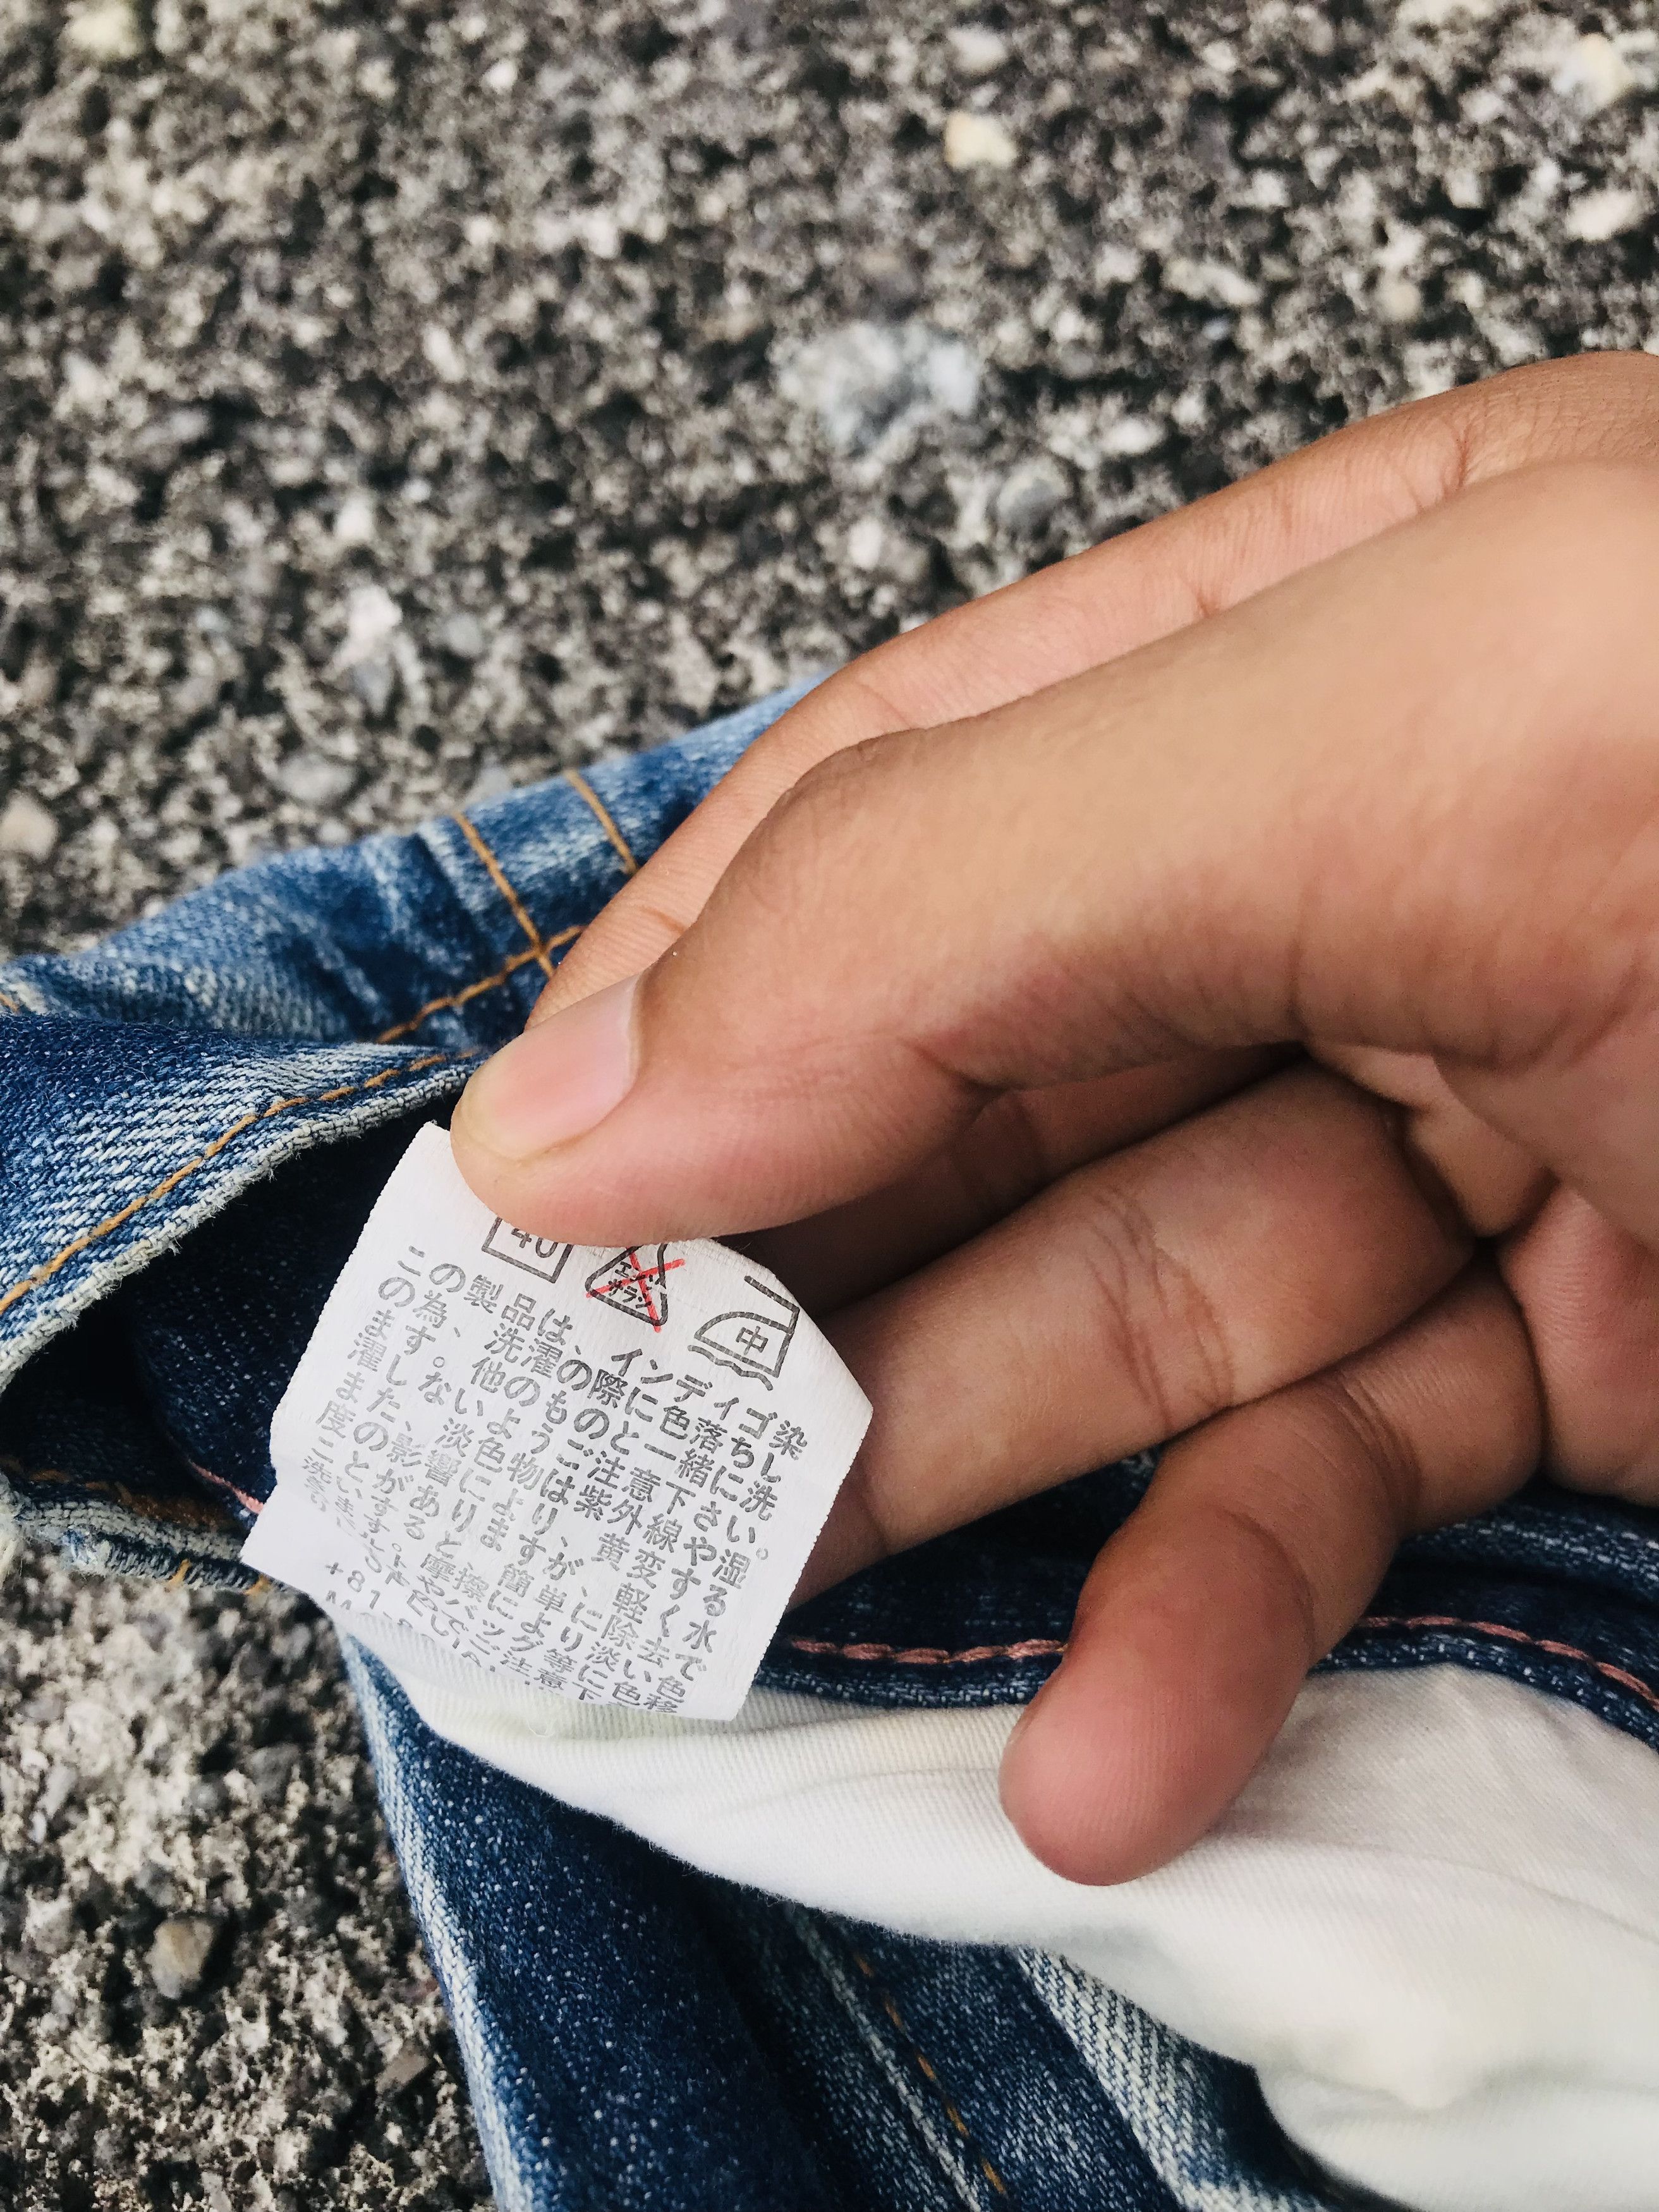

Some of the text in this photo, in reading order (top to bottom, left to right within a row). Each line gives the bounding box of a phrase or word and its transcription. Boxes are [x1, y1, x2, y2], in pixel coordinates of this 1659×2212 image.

[348, 1332, 769, 1560] 濯しないようご注意下さい。
[364, 1310, 777, 1521] ます。他のものと一緒に洗
[379, 1277, 781, 1483] の為、洗濯の際に色落ちし
[398, 1245, 807, 1460] この製品は、インディゴ染
[735, 1326, 769, 1355] 中
